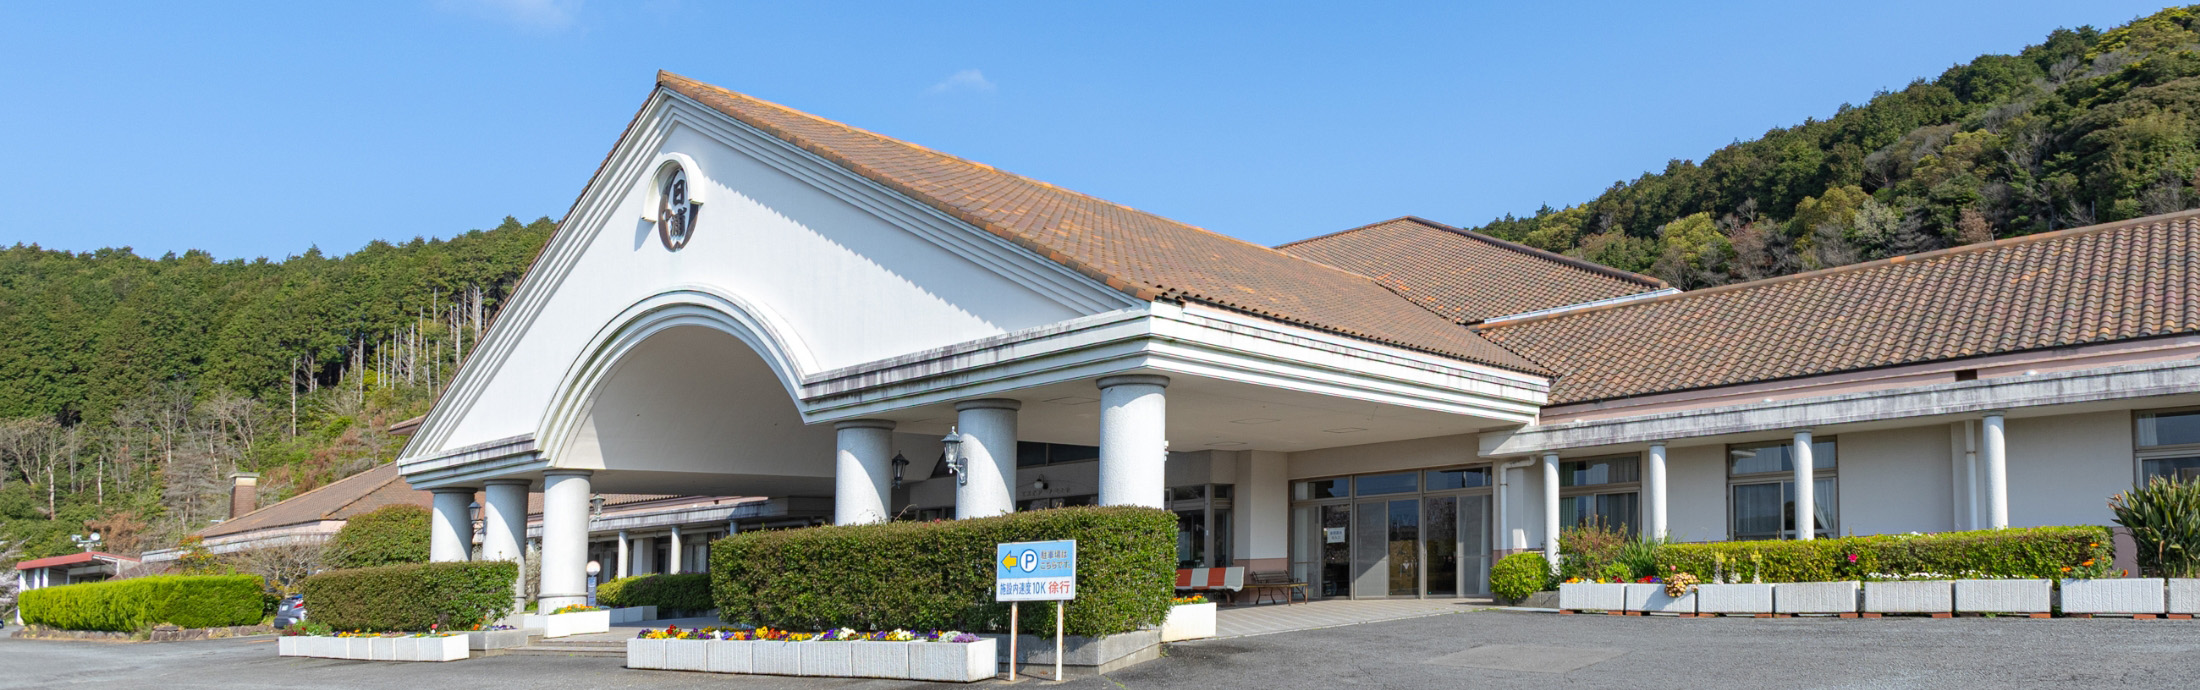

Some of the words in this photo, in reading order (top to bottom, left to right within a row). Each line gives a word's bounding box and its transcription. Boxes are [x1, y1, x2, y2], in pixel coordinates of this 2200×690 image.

[1026, 554, 1035, 568] P
[1041, 550, 1067, 559] 駐車場は
[1049, 581, 1070, 594] 徐行
